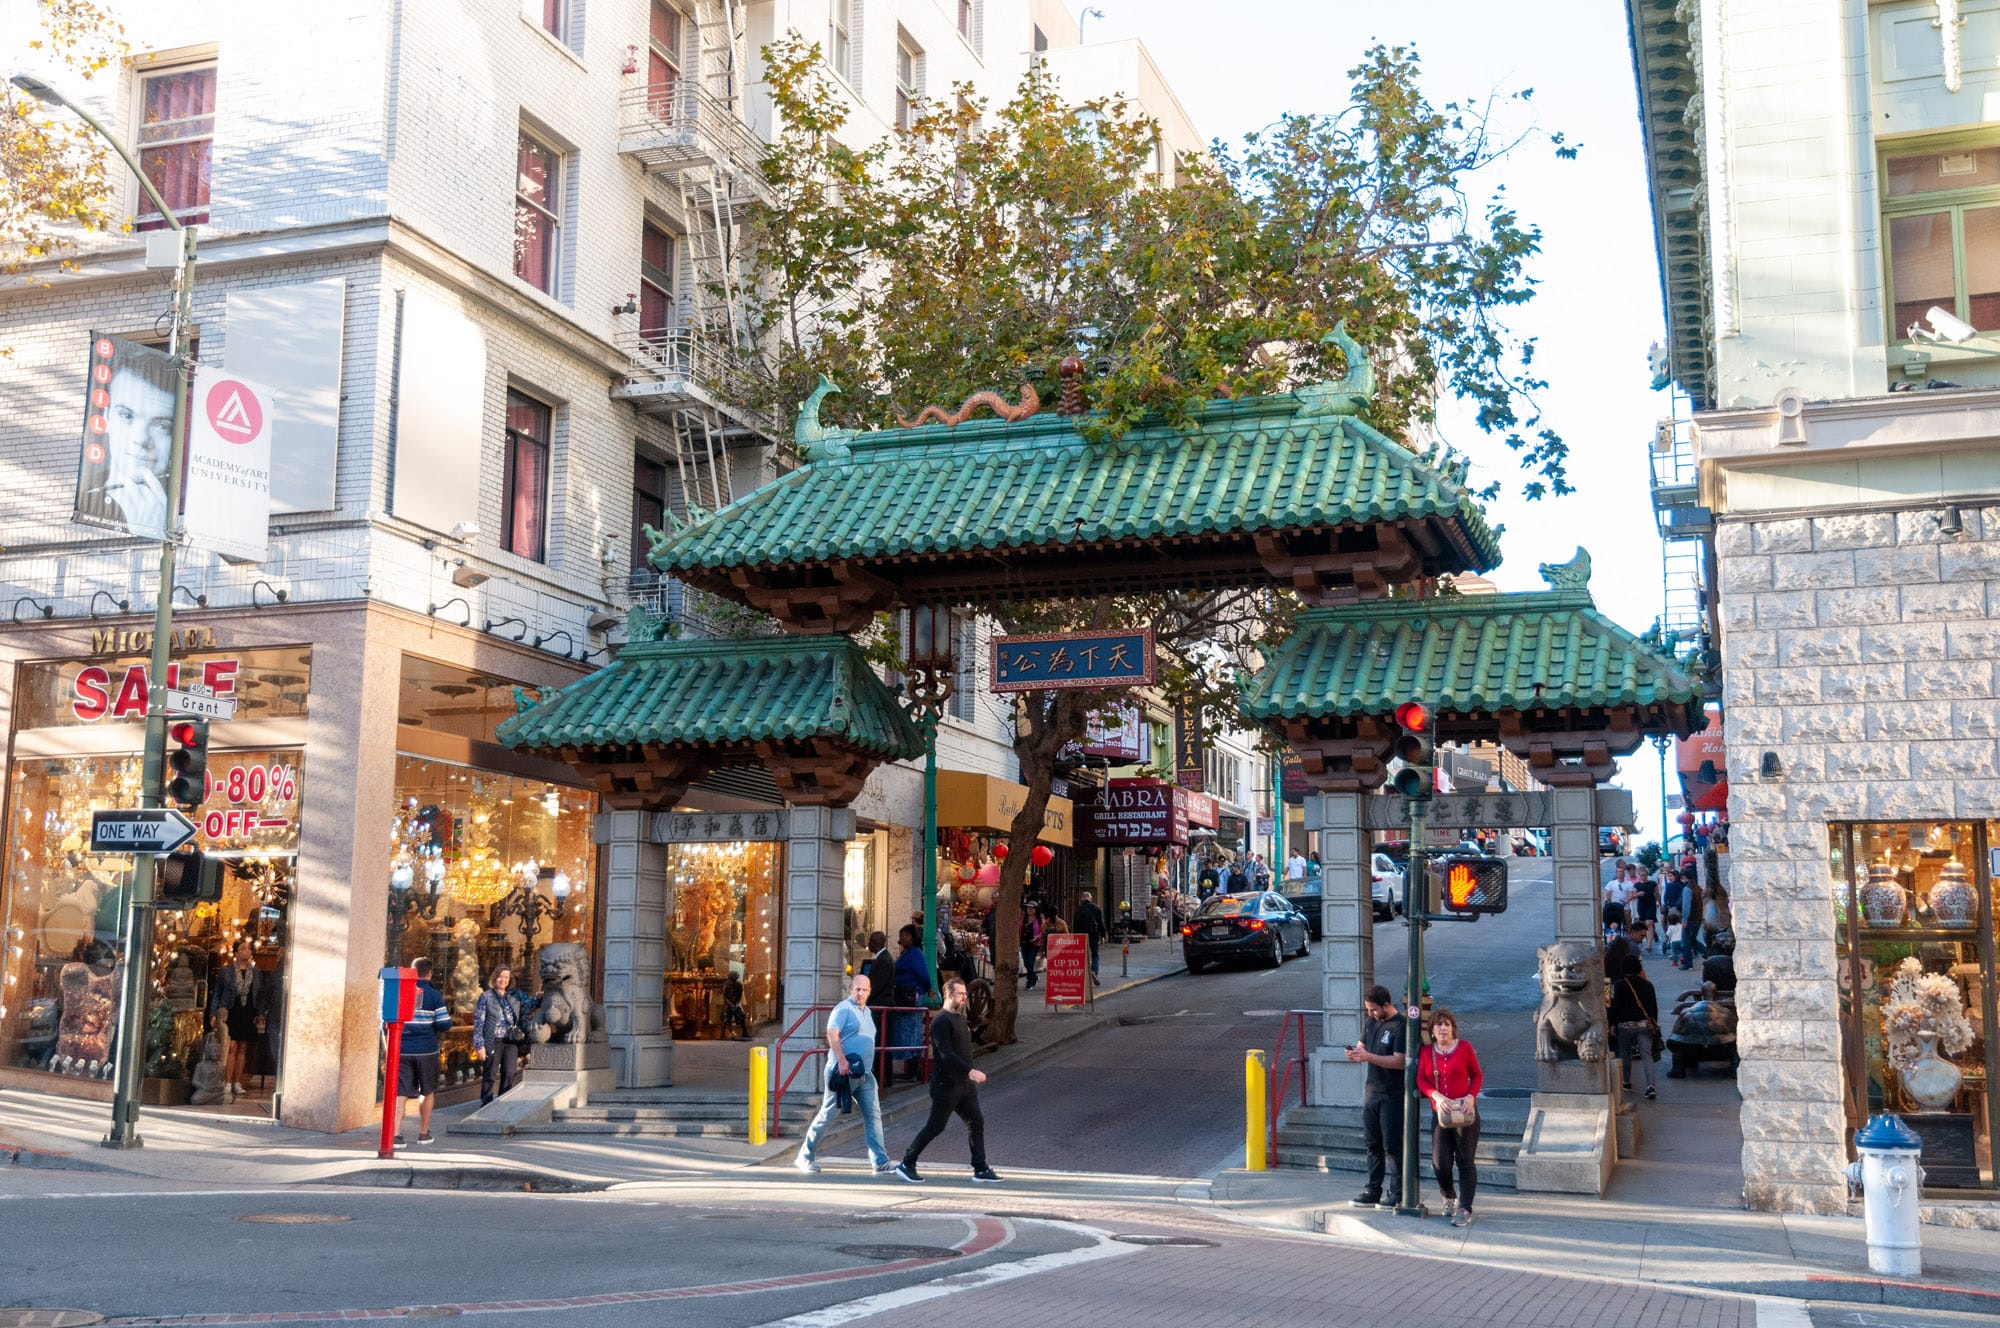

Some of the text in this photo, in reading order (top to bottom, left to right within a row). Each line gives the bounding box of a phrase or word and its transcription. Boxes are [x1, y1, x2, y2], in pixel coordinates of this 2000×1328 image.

[89, 341, 111, 461] BUILD
[193, 454, 241, 473] ACADEMY
[250, 468, 268, 480] ART
[191, 466, 269, 492] UNIVERSITY
[192, 684, 206, 694] 400
[182, 697, 218, 714] Grant
[1473, 770, 1488, 781] PLAZA
[1094, 790, 1168, 807] SABRA
[1045, 808, 1064, 831] FTS
[1094, 812, 1117, 820] GRILL
[1117, 811, 1168, 820] RESTAURANT
[100, 824, 160, 839] ONE WAY
[205, 810, 258, 839] OFF
[1068, 959, 1079, 967] TO
[1049, 968, 1084, 977] 70% OFF
